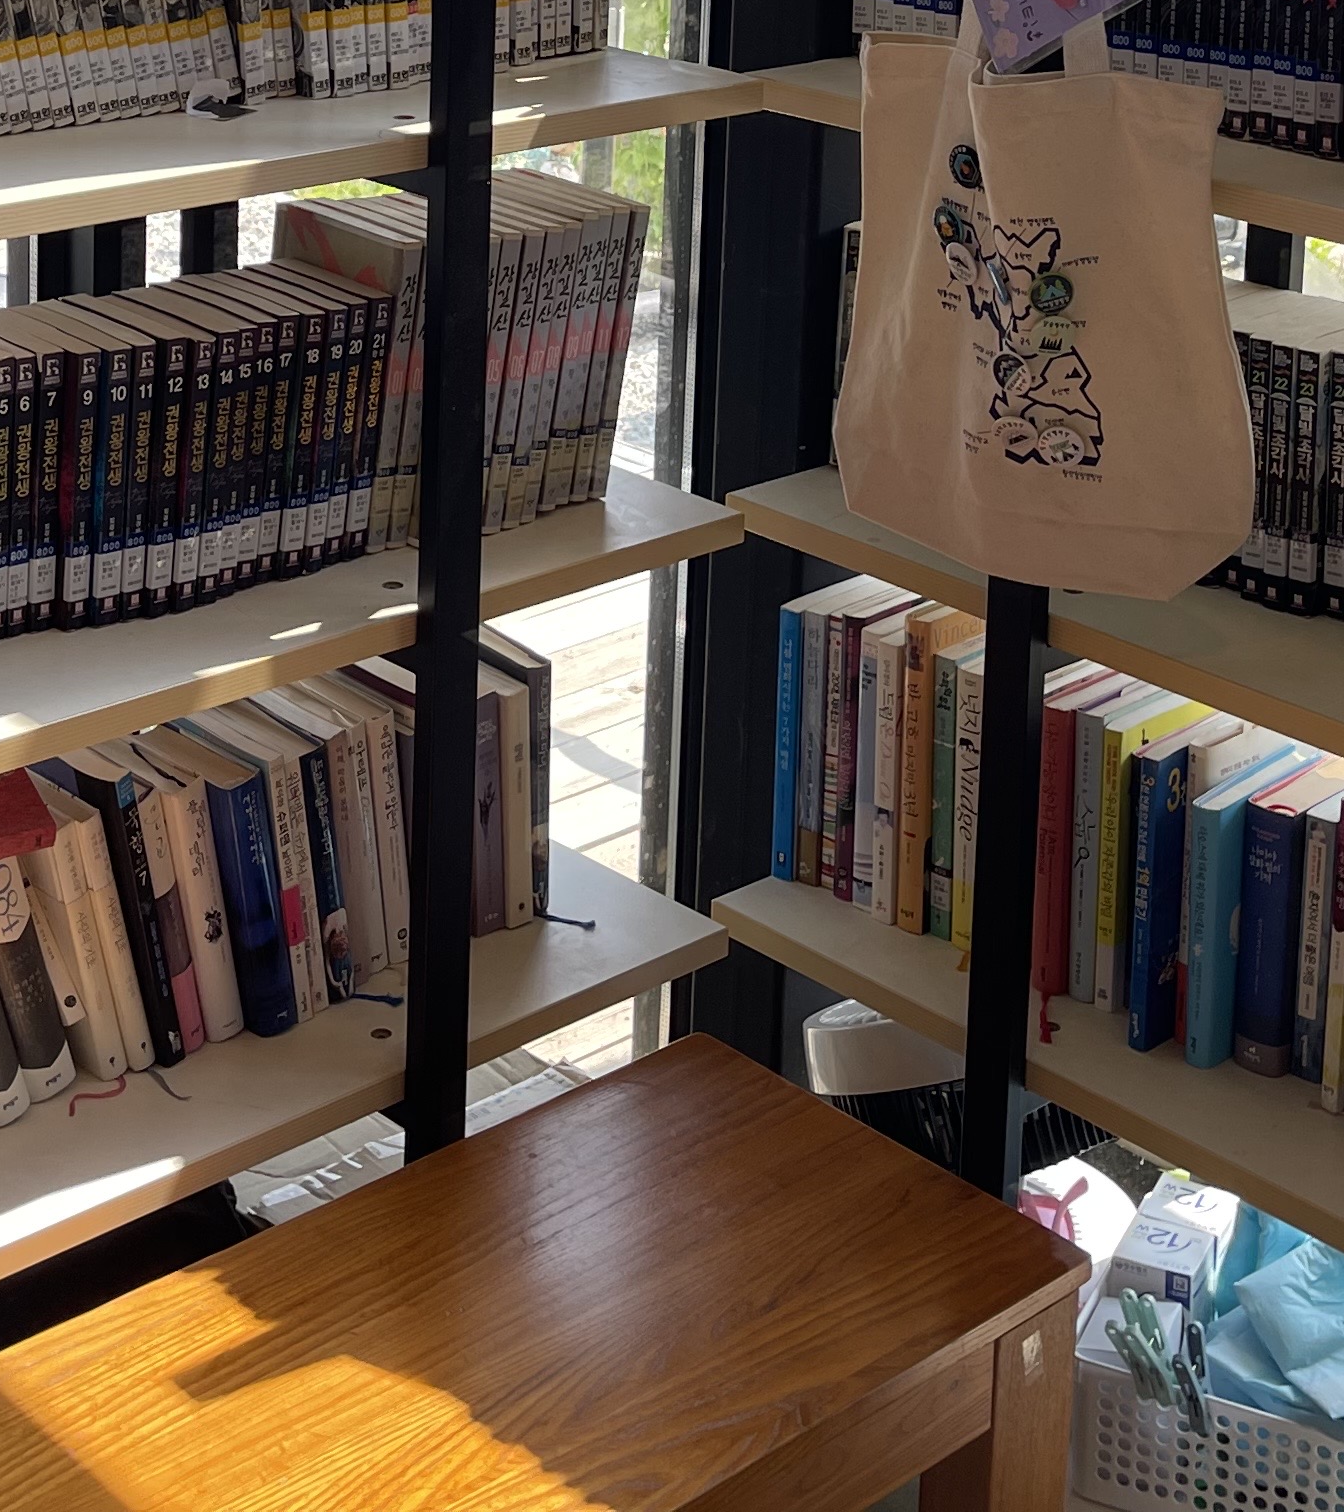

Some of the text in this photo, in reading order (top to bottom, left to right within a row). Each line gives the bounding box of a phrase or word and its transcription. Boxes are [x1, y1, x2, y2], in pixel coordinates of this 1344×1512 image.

[493, 265, 515, 332] 장길산
[110, 385, 127, 402] 10
[167, 377, 184, 393] 12
[955, 753, 979, 842] Nudge
